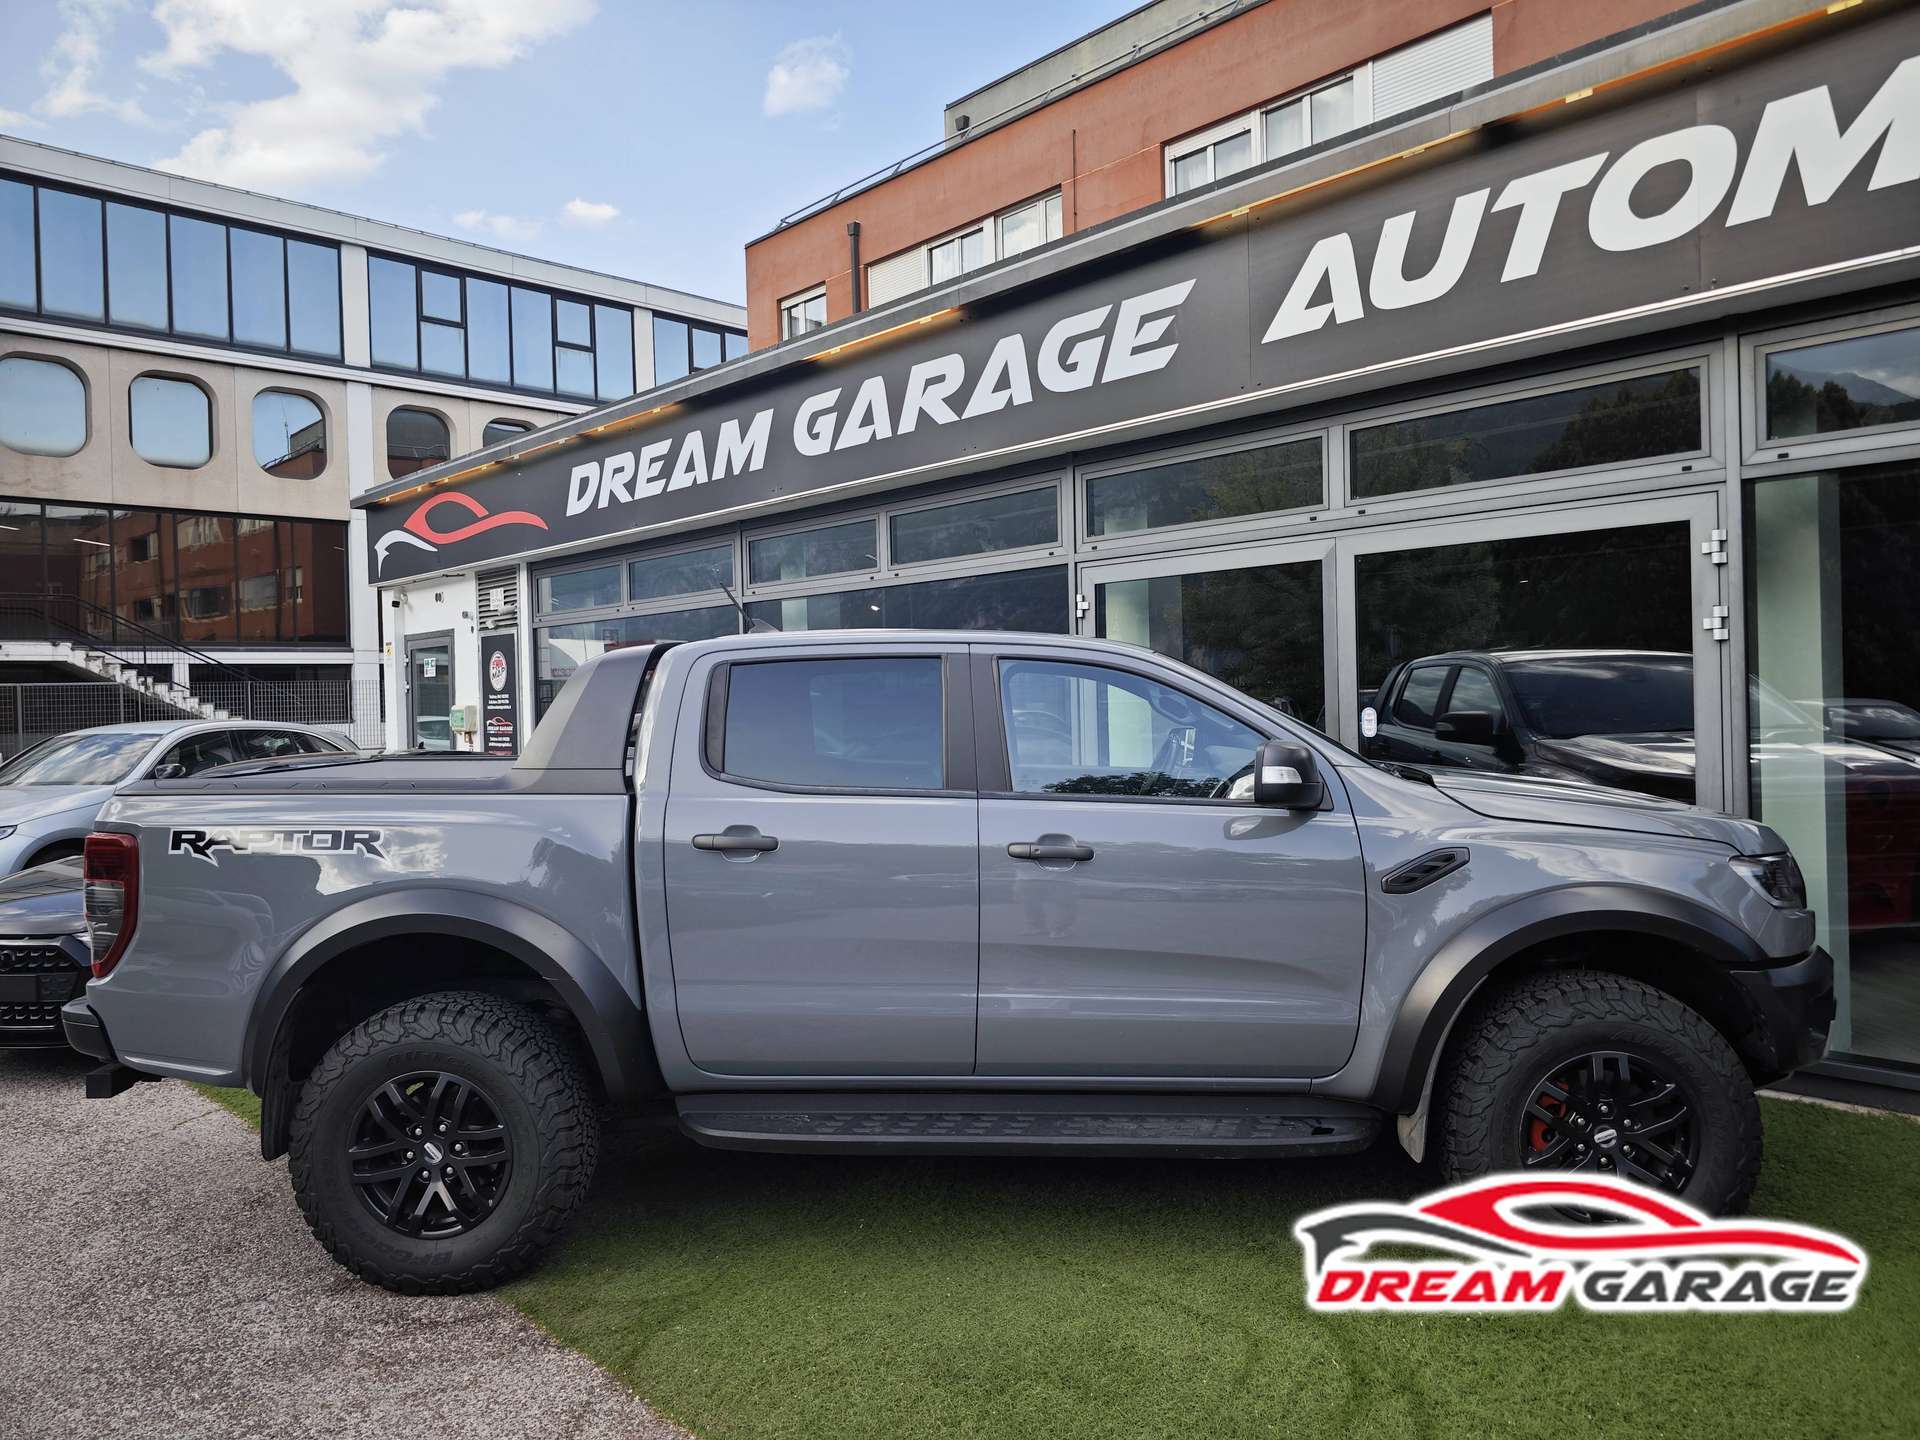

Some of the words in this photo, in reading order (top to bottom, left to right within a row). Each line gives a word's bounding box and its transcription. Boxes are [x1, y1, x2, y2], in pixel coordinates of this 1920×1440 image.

[566, 408, 774, 516] DREAM
[794, 279, 1197, 456] GARAGE
[1261, 56, 1920, 344] AUTOM
[168, 828, 390, 867] RAPTOR
